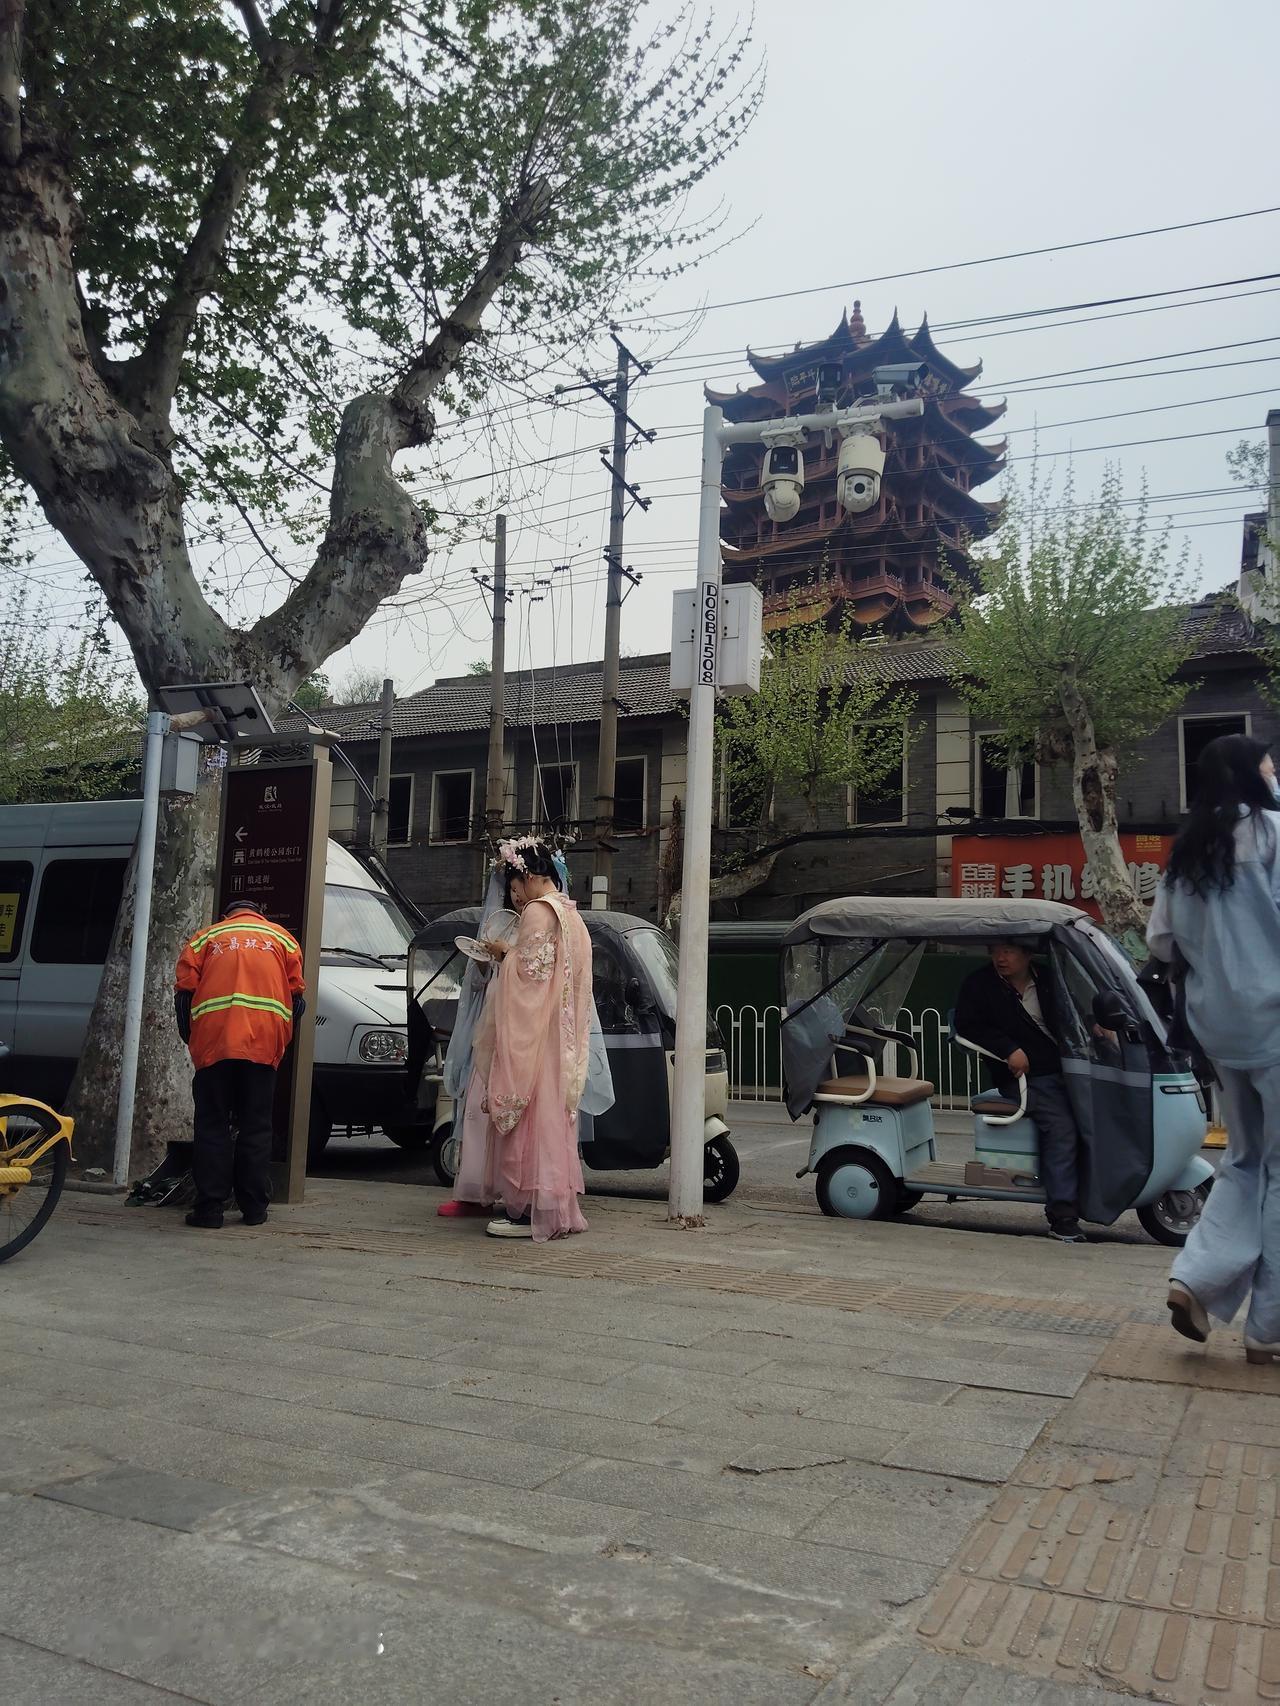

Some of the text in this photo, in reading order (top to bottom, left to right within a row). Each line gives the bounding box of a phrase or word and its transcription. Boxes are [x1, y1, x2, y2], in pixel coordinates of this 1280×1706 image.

[703, 584, 718, 683] D06B1508
[960, 863, 997, 882] 百宝
[960, 883, 997, 899] 科技
[211, 936, 275, 955] 武昌环卫
